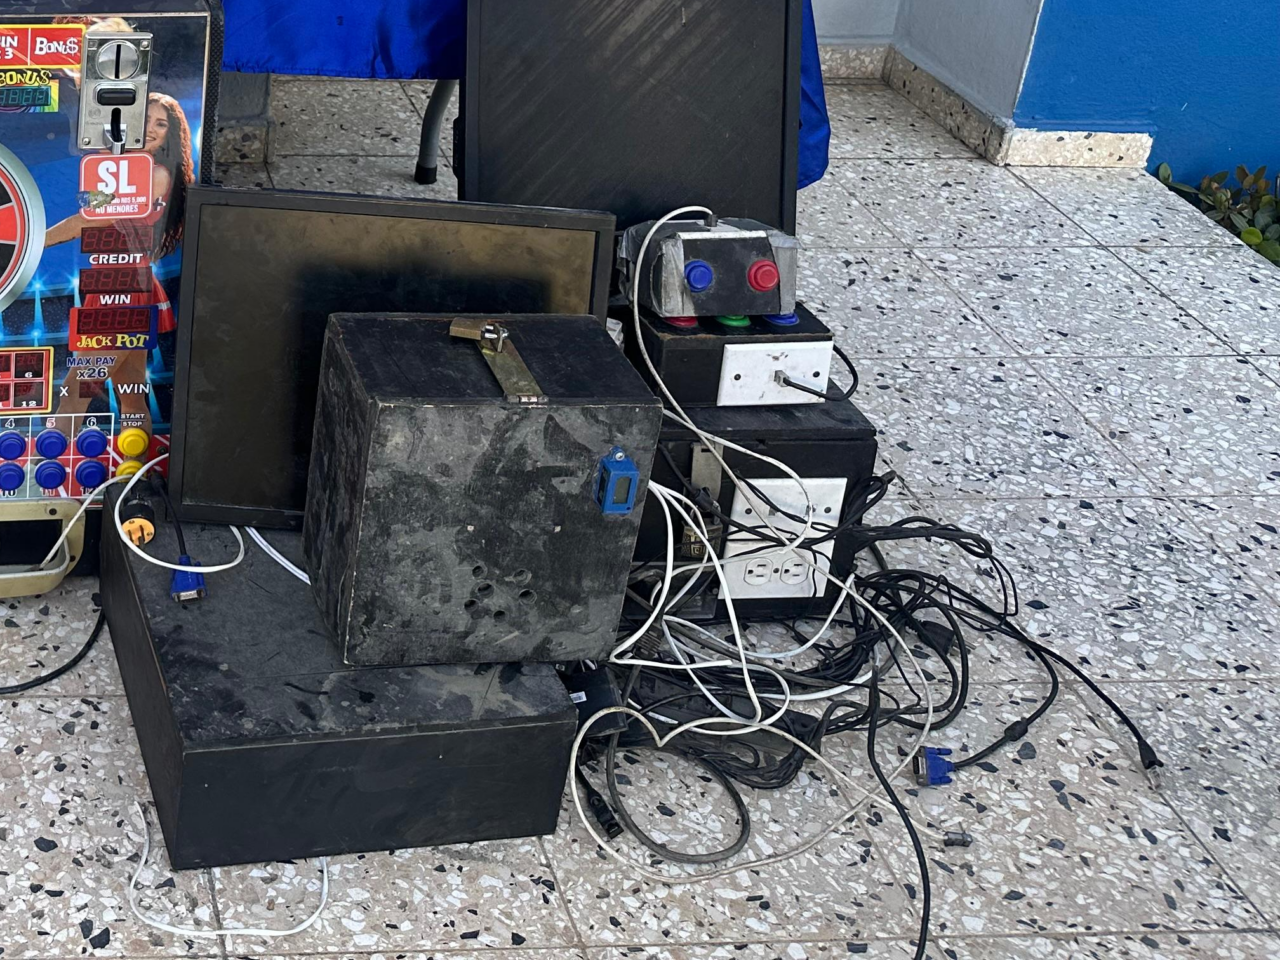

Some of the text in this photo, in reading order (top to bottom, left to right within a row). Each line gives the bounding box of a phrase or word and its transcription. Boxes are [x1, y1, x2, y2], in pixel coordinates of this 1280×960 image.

[97, 160, 137, 194] SL
[106, 205, 139, 214] MENORES
[89, 253, 143, 265] CREDIT
[99, 294, 131, 305] WIN
[76, 335, 113, 349] JACK
[67, 356, 117, 367] MAX PAY
[117, 383, 151, 395] WIN
[5, 418, 15, 429] 4
[46, 418, 55, 428] 5
[87, 417, 96, 428] 6
